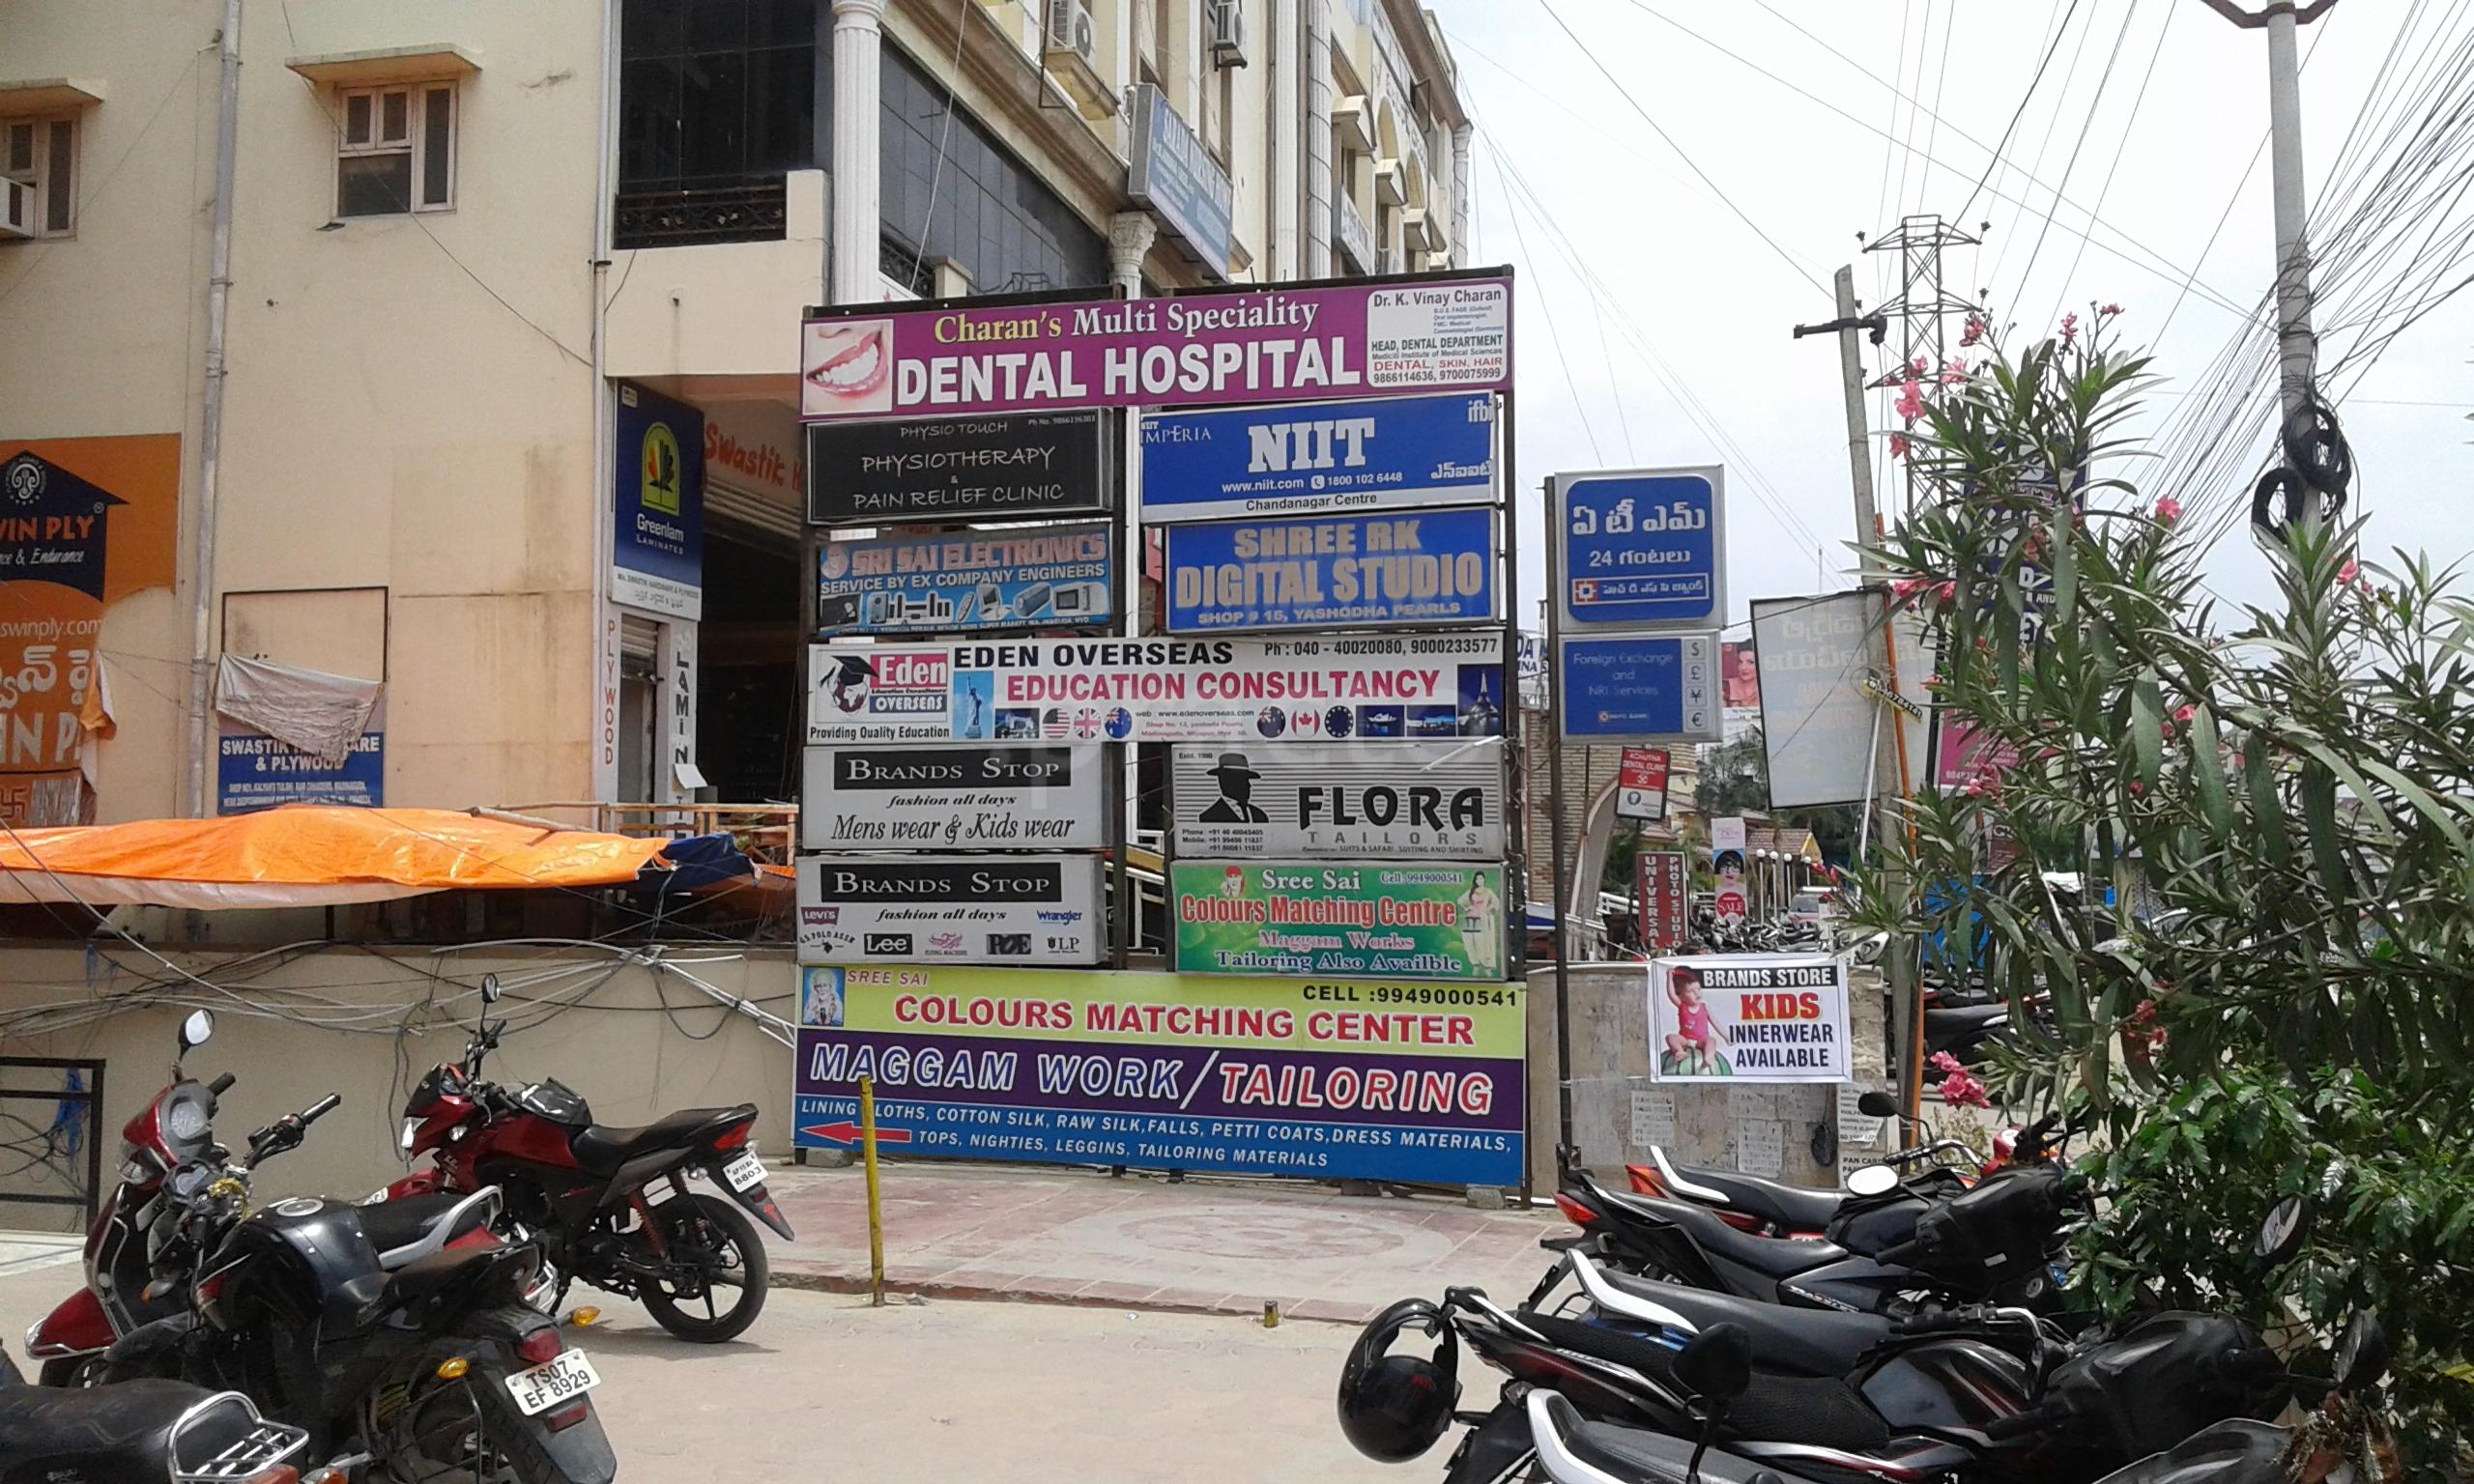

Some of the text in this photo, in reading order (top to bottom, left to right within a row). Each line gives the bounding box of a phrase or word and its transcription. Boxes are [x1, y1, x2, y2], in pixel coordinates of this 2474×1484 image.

[1373, 289, 1502, 307] Dr. K. Vinay Charan
[935, 296, 1319, 343] Charan's Multi Speciality
[1401, 338, 1437, 350] DENTAL
[1440, 334, 1503, 349] DEPARTMENT
[897, 336, 1361, 406] DENTAL HOSPITAL
[1474, 357, 1503, 367] HAIR
[900, 421, 1008, 441] PHYSIO TOUCH
[705, 422, 786, 487] Swastik
[1248, 417, 1375, 472] NIIT
[861, 445, 1056, 478] PHYSIOTHERAPY
[1222, 471, 1402, 493] www.niit.com 1800 102 6448
[853, 483, 1065, 509] PAIN RELIEF CLINIC
[1246, 493, 1377, 512] Chandanagar Centre
[45, 515, 95, 540] PLY
[637, 513, 684, 542] Greenlam
[1572, 505, 1597, 535] ఏ
[636, 535, 684, 556] LAMINATES
[1234, 520, 1422, 558] SHREE RK
[29, 548, 85, 564] Endurance
[851, 533, 1107, 577] SRI SAI ELECTRONICS
[1589, 550, 1612, 567] 24
[820, 564, 1106, 594] SERVICE BY EX COMPANY ENGINEERS
[1175, 552, 1483, 609] DIGITAL STUDIO
[1198, 612, 1244, 624] SHOP
[1294, 606, 1387, 620] YASHODHA
[1393, 603, 1460, 616] PEARLS
[954, 645, 1039, 669] EDEN
[1053, 642, 1233, 667] OVERSEAS
[1294, 642, 1319, 655] 040
[1410, 639, 1498, 654] 9000233577
[1573, 652, 1616, 667] Foreign
[879, 656, 947, 685] Eden
[1612, 669, 1635, 680] and
[604, 618, 617, 765] PLYWOOD
[1008, 670, 1440, 701] EDUCATION CONSULTANCY
[810, 725, 950, 741] Providing Quality Education
[255, 756, 267, 771] &
[846, 757, 1060, 781] BRANDS STOP
[886, 794, 1017, 809] fashion all days
[1298, 785, 1484, 832] FLORA
[830, 813, 1076, 844] Mens wear & Kids wear
[1308, 831, 1477, 845] TAILORS
[833, 871, 1050, 893] BRANDS STOP
[1262, 870, 1314, 890] Sree
[1322, 870, 1361, 890] Sai
[1181, 895, 1457, 928] Colours Matching Centre
[1645, 856, 1659, 949] UNIVERSAL
[1669, 856, 1682, 948] PHOTO STUDIO
[1718, 900, 1743, 912] SALE
[875, 908, 1007, 924] fashion all days
[1036, 909, 1083, 926] Wrangler
[866, 934, 908, 952] Lee
[1259, 931, 1415, 951] Maggam Works
[1216, 951, 1461, 973] Tailoring Also Availble
[847, 969, 928, 986] SREE SAI
[1703, 968, 1831, 987] BRANDS STORE
[1303, 985, 1360, 1002] CELL
[1740, 992, 1821, 1020] KIDS
[895, 994, 1477, 1045] COLOURS MATCHING CENTER
[1729, 1024, 1833, 1043] INNERWEAR
[811, 1042, 1018, 1092] MAGGAM
[1736, 1048, 1829, 1068] AVAILABLE
[801, 1099, 1511, 1153] LINING LOTHS, COTTON SILK, RAW PETTI MATERIALS,
[919, 1131, 1328, 1167] TOPS, NIGHTIES, LEGGINS, TAILORING MATERIALS
[734, 1166, 762, 1185] 8803
[526, 1360, 568, 1387] TS07
[524, 1370, 590, 1409] EF 8929
